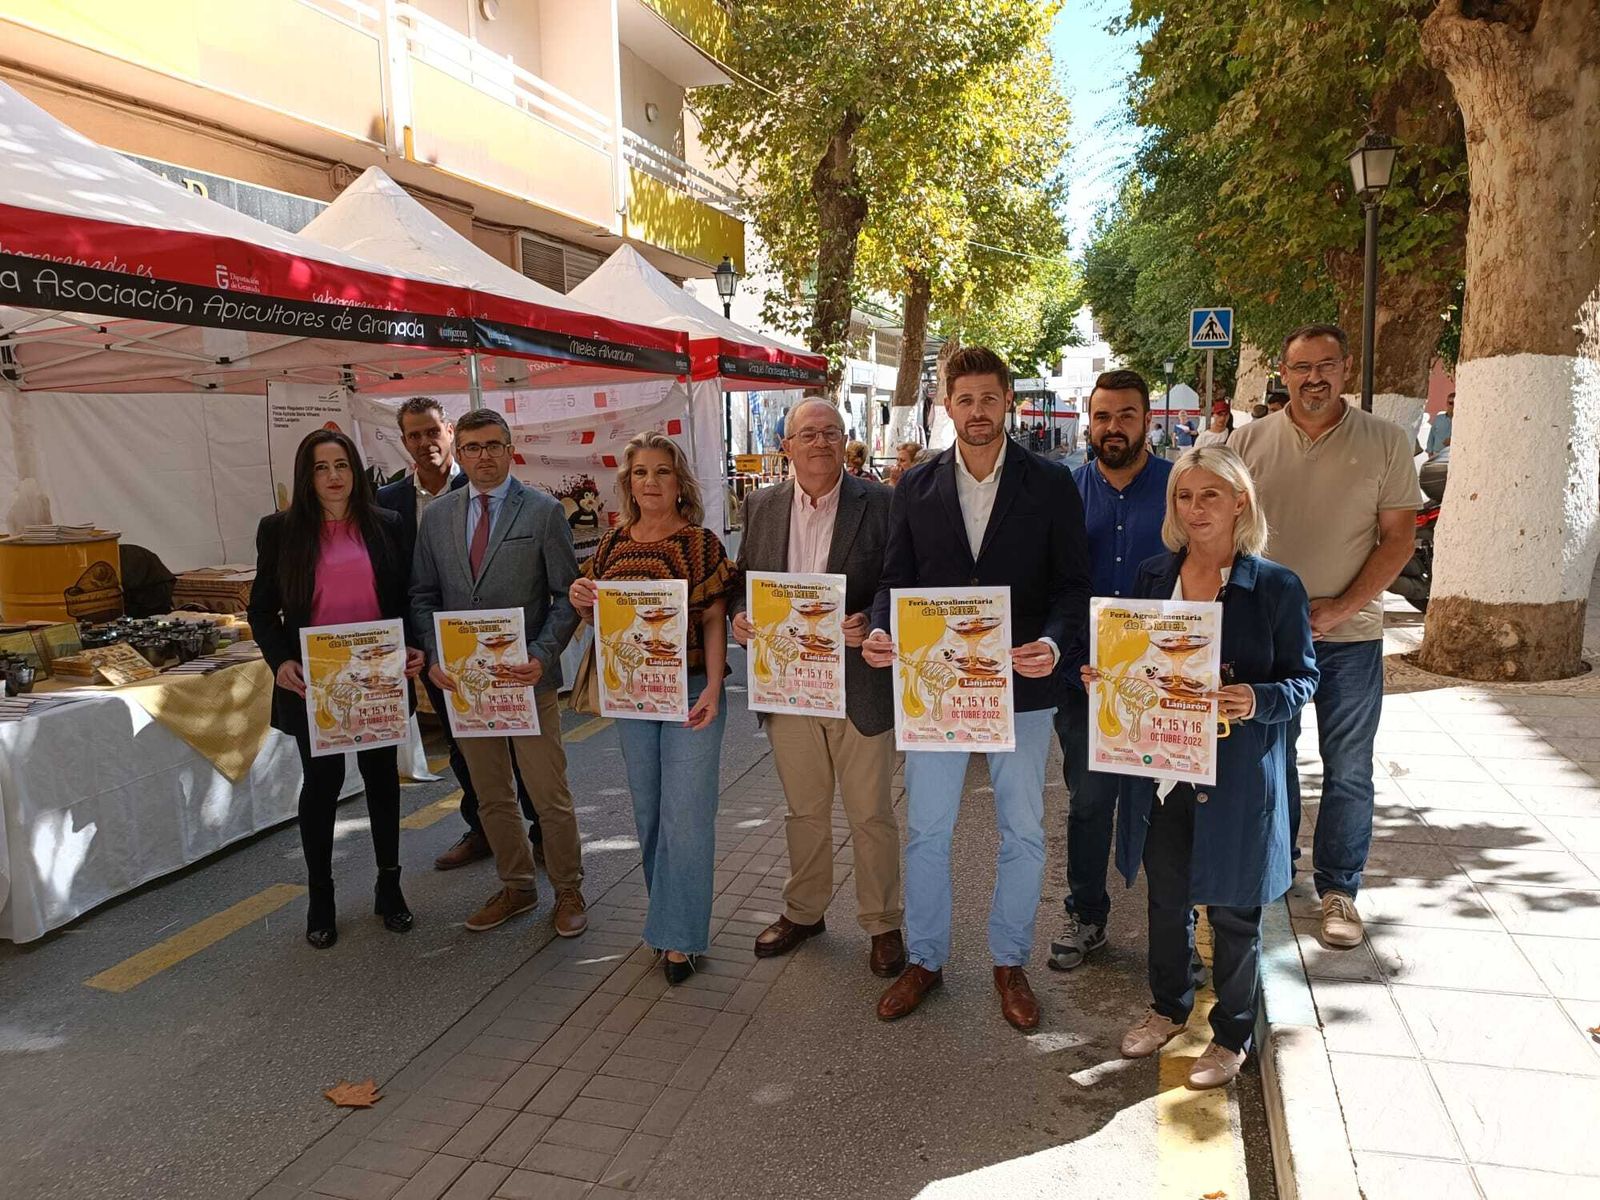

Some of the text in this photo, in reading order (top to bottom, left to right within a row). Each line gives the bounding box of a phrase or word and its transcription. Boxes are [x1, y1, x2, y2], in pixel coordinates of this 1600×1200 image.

[33, 269, 193, 314] Asociación
[203, 295, 325, 328] Apicultores
[331, 307, 353, 332] de
[357, 314, 425, 339] Granada
[569, 340, 596, 357] Mieles
[598, 344, 635, 362] Alvarium
[778, 583, 831, 591] Agroalimentaria
[771, 589, 783, 597] de
[794, 590, 819, 599] MIEL
[616, 597, 627, 606] de
[638, 597, 662, 606] MIEL
[929, 599, 993, 607] Agroalimentaria
[922, 606, 980, 616] de la MIEL
[1110, 611, 1131, 619] Feria
[1123, 620, 1139, 630] de
[1153, 621, 1187, 631] MIEL
[336, 630, 389, 639] Agroalimentaria
[804, 653, 837, 662] Lanjarón
[649, 659, 680, 667] Lanjarón
[652, 674, 660, 683] 15
[662, 674, 666, 683] Y
[668, 674, 676, 684] 16
[807, 669, 815, 679] 15
[818, 669, 822, 679] Y
[825, 670, 833, 680] 16
[819, 681, 834, 689] 2022
[963, 678, 1003, 688] Lanjarón
[663, 685, 677, 693] 2022
[500, 694, 508, 703] 15
[516, 694, 524, 703] 16
[968, 696, 977, 708] 15
[980, 696, 986, 707] Y
[990, 696, 999, 707] 16
[372, 706, 380, 714] 15
[389, 704, 398, 712] 16
[1166, 699, 1208, 710] Lanjarón
[951, 711, 1000, 719] OCTUBRE 2022
[1169, 719, 1179, 732] 15
[1182, 720, 1188, 732] Y
[1191, 721, 1202, 734] 16
[1150, 732, 1202, 747] OCTUBRE 2022
